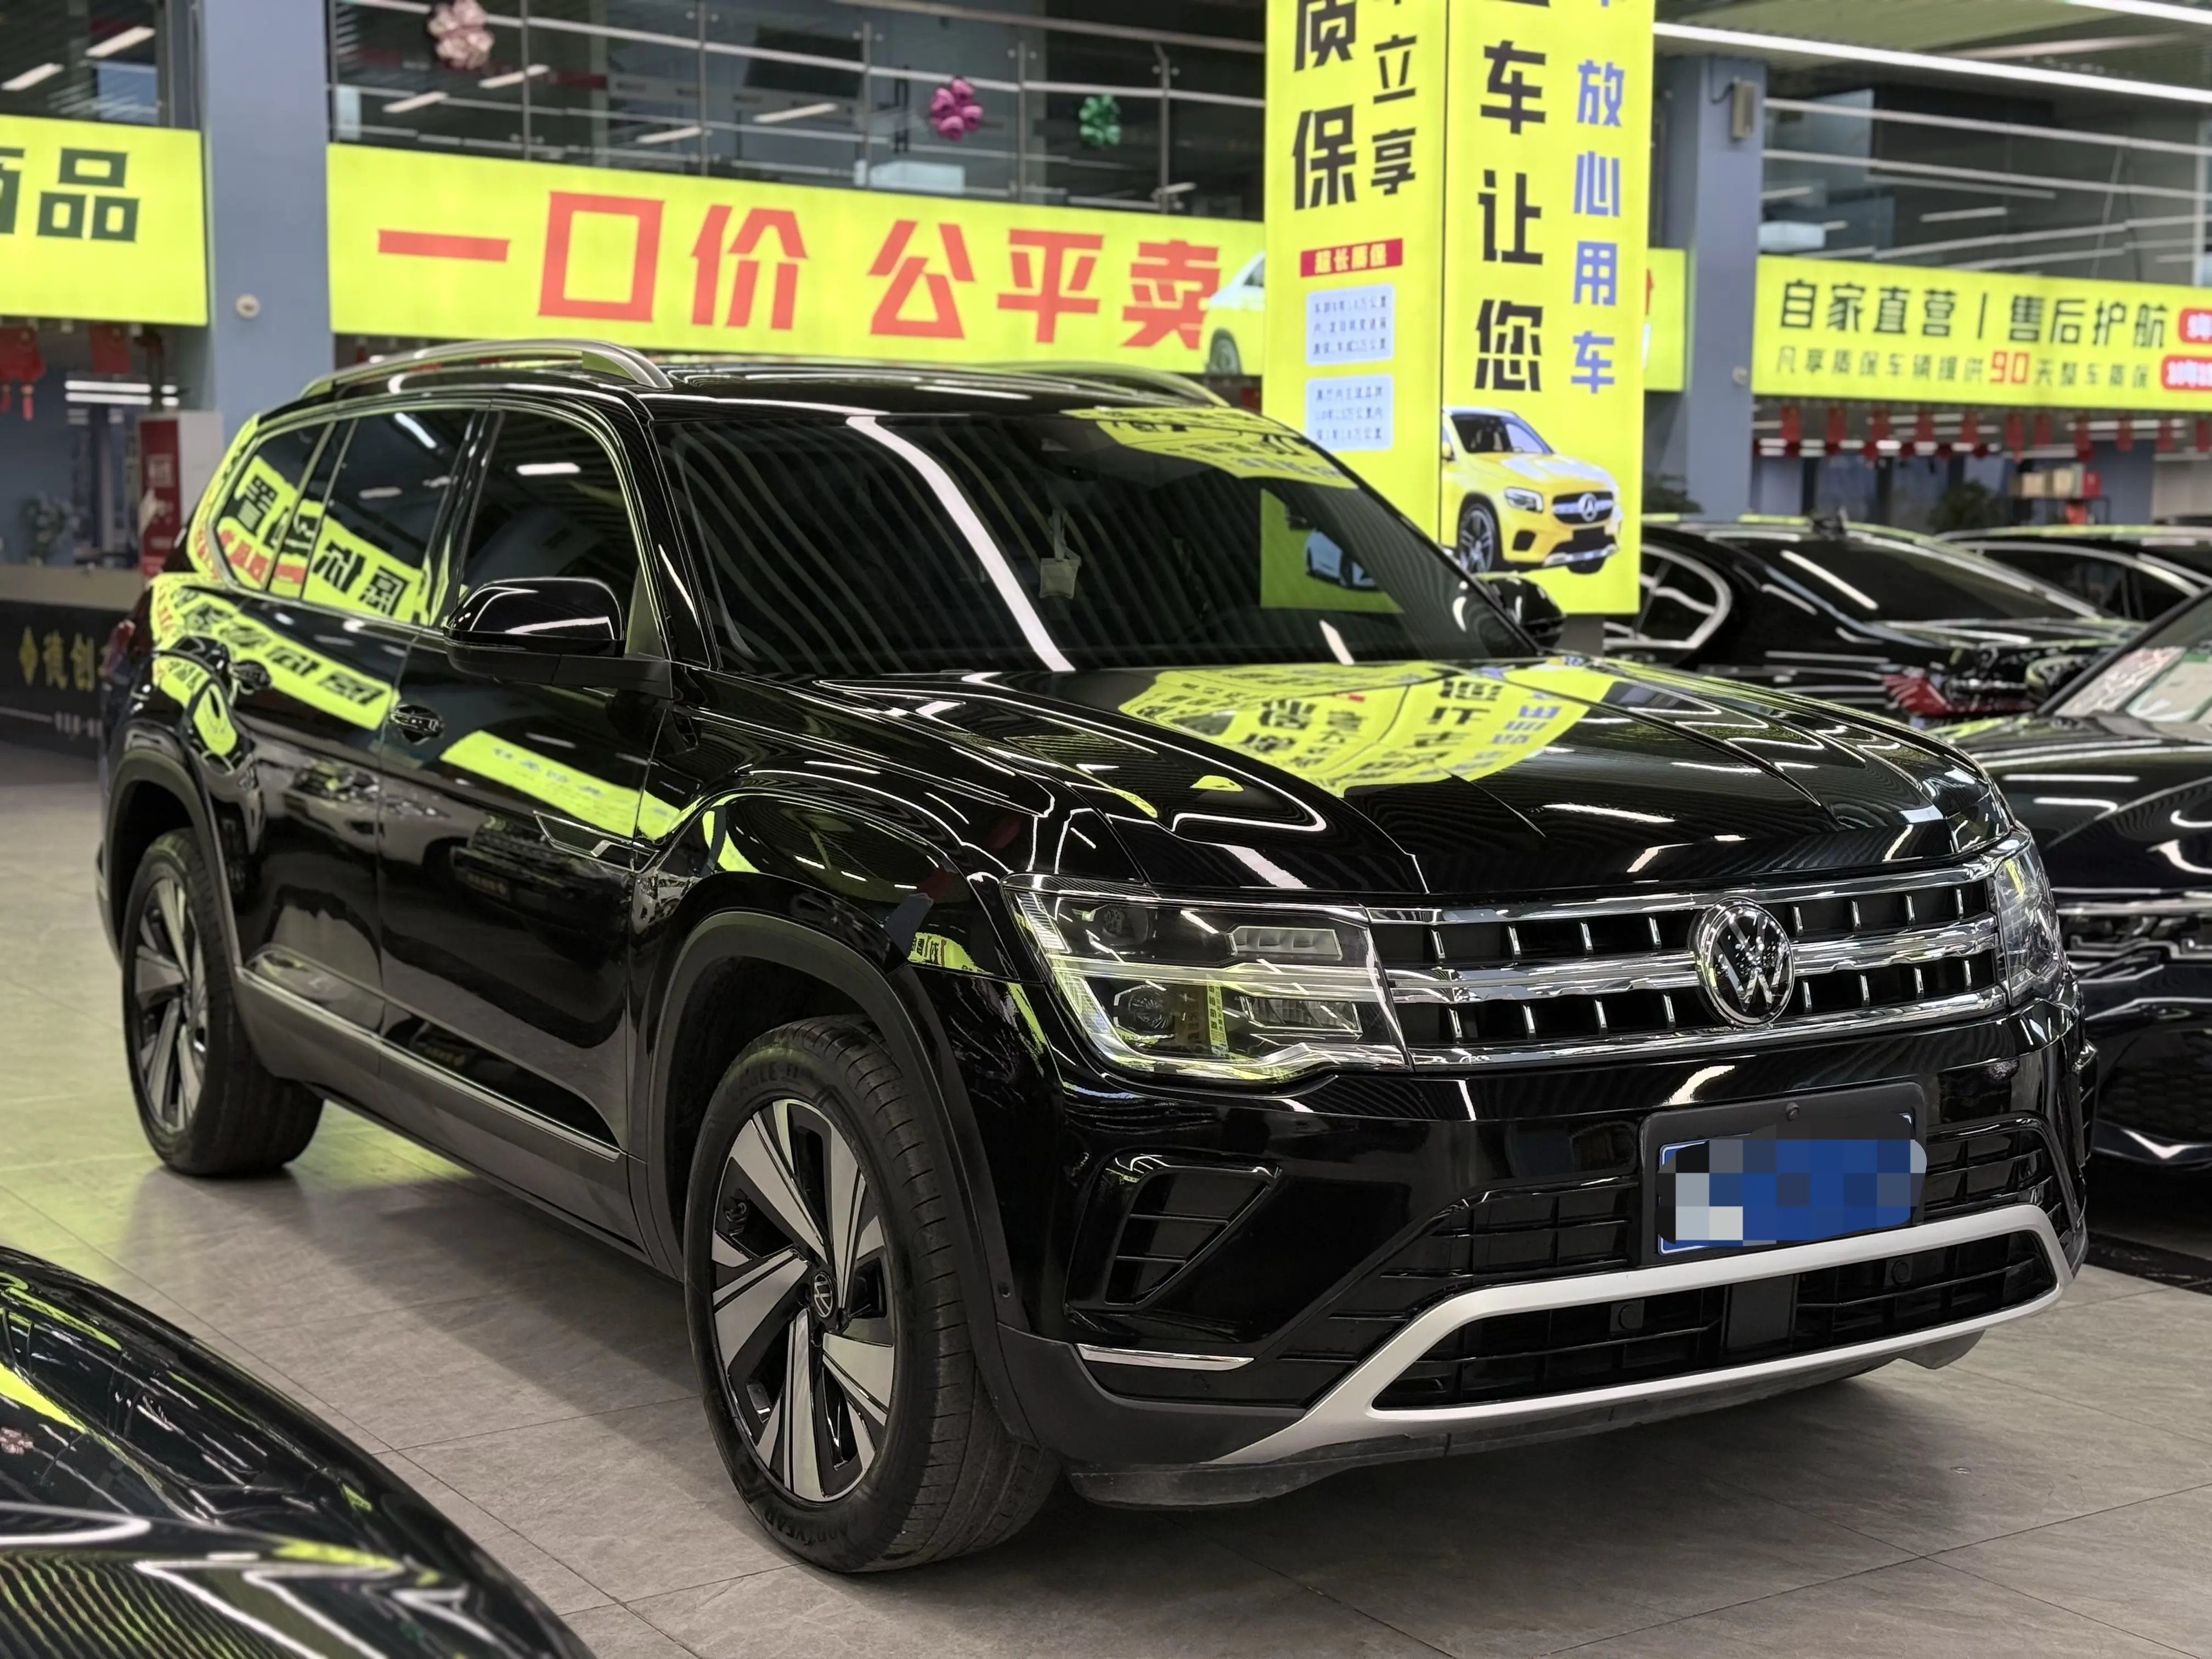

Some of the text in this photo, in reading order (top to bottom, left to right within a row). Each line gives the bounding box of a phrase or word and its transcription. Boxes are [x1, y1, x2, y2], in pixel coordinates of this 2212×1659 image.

[0, 146, 140, 243] 品
[1370, 0, 1417, 196] 立享
[1474, 0, 1550, 392] 车让您
[377, 190, 1221, 350] 一口价 公平卖
[1570, 59, 1625, 394] 放心用车
